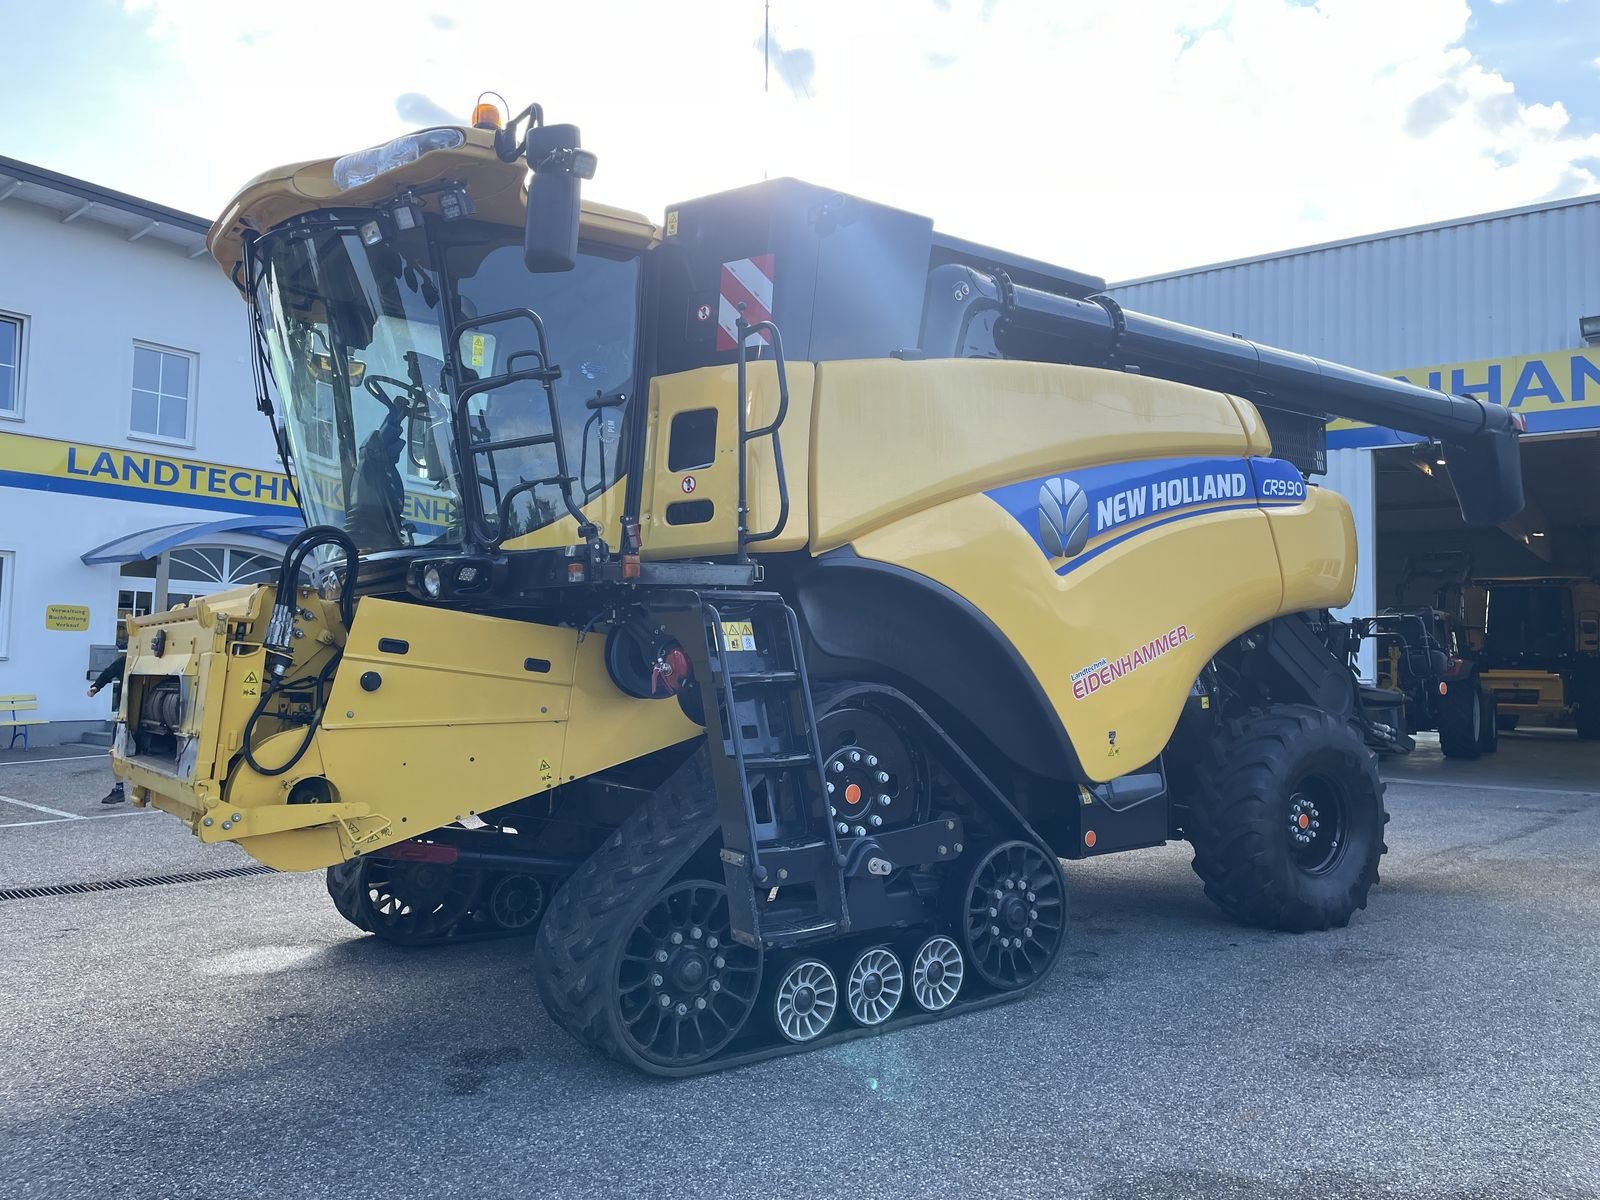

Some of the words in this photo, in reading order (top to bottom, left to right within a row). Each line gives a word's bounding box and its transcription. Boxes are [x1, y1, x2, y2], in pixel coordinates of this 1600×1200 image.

[1262, 479, 1303, 496] CR9.90
[1097, 486, 1147, 531] NEW
[1152, 473, 1246, 511] HOLLAND
[48, 614, 88, 622] Buchhaltung
[51, 607, 86, 615] Verwaltung
[1071, 658, 1107, 681] Landtechnik
[1073, 625, 1188, 699] EIDENHAMMER
